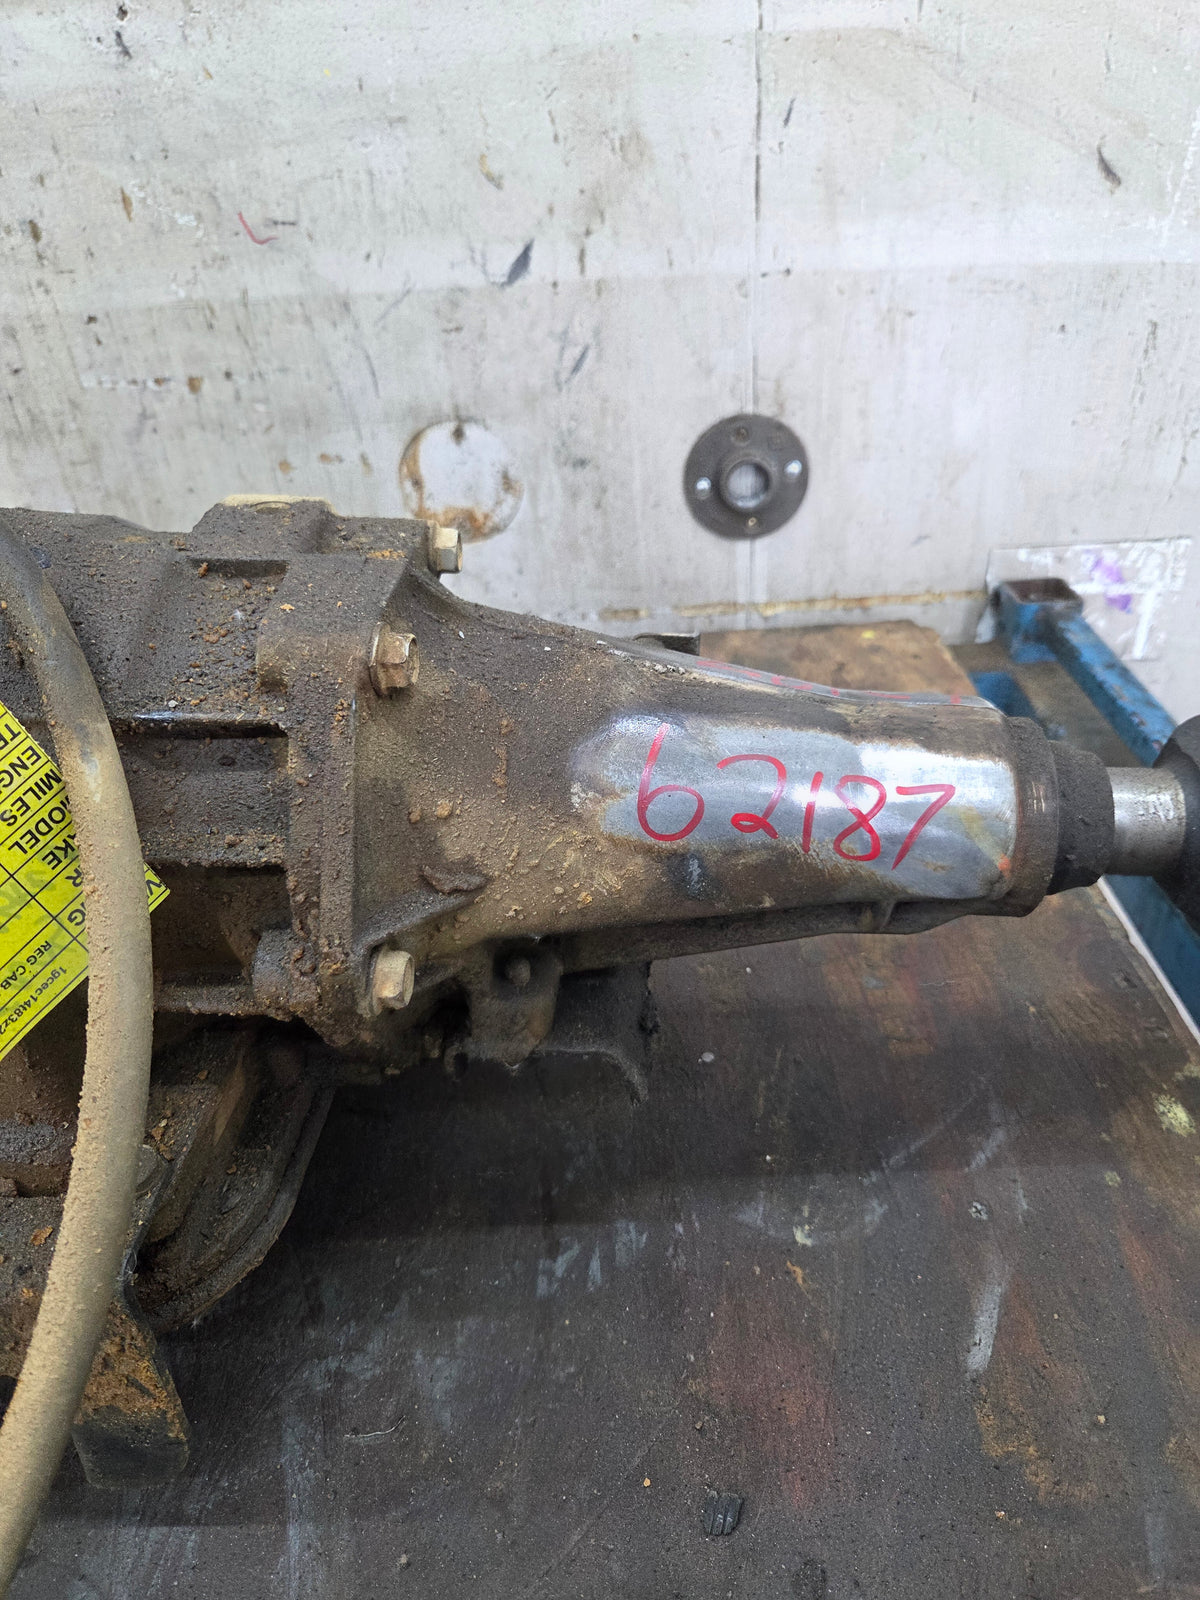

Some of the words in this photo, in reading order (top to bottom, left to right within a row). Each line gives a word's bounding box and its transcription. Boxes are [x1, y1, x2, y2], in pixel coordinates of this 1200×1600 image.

[0, 745, 42, 795] ENG
[0, 768, 62, 827] MILES
[637, 723, 956, 871] 62187
[0, 965, 27, 990] CAB
[26, 940, 53, 966] REG
